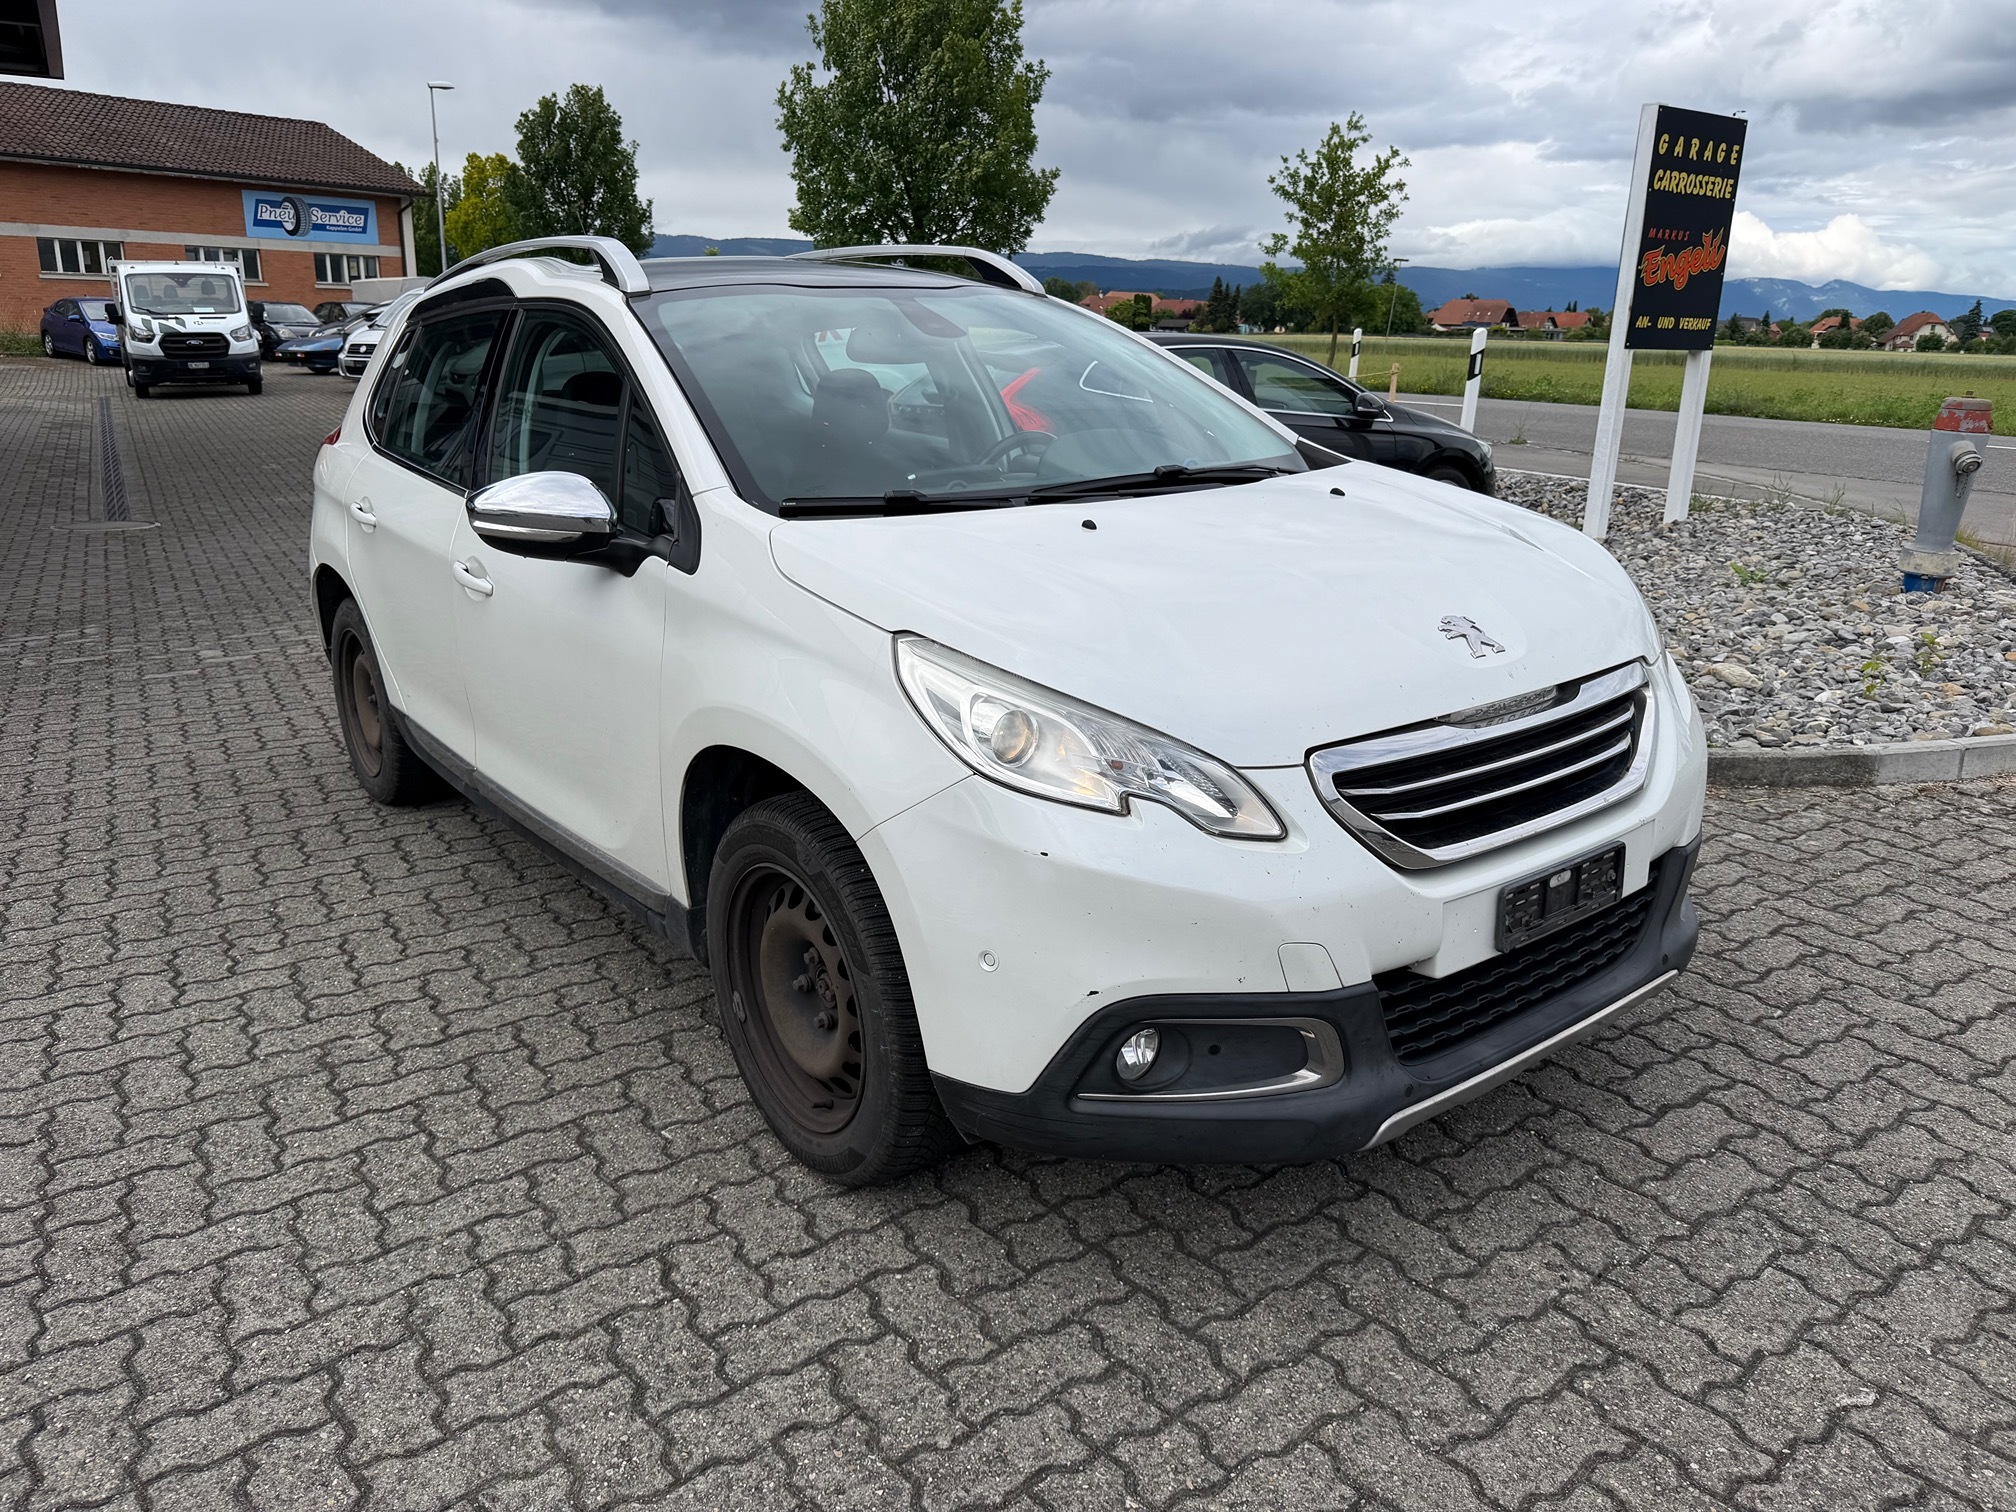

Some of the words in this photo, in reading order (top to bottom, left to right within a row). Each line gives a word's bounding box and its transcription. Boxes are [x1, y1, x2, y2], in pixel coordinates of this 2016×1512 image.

[1658, 133, 1740, 165] GARAGE
[1653, 168, 1734, 199] CARROSSERIE
[259, 205, 296, 221] Pneu
[311, 208, 363, 225] Service
[1648, 227, 1690, 242] MARKUS
[1640, 227, 1726, 291] Engeli
[1635, 315, 1652, 329] AN-
[1657, 316, 1675, 330] UND
[1679, 317, 1712, 331] VERKAUF
